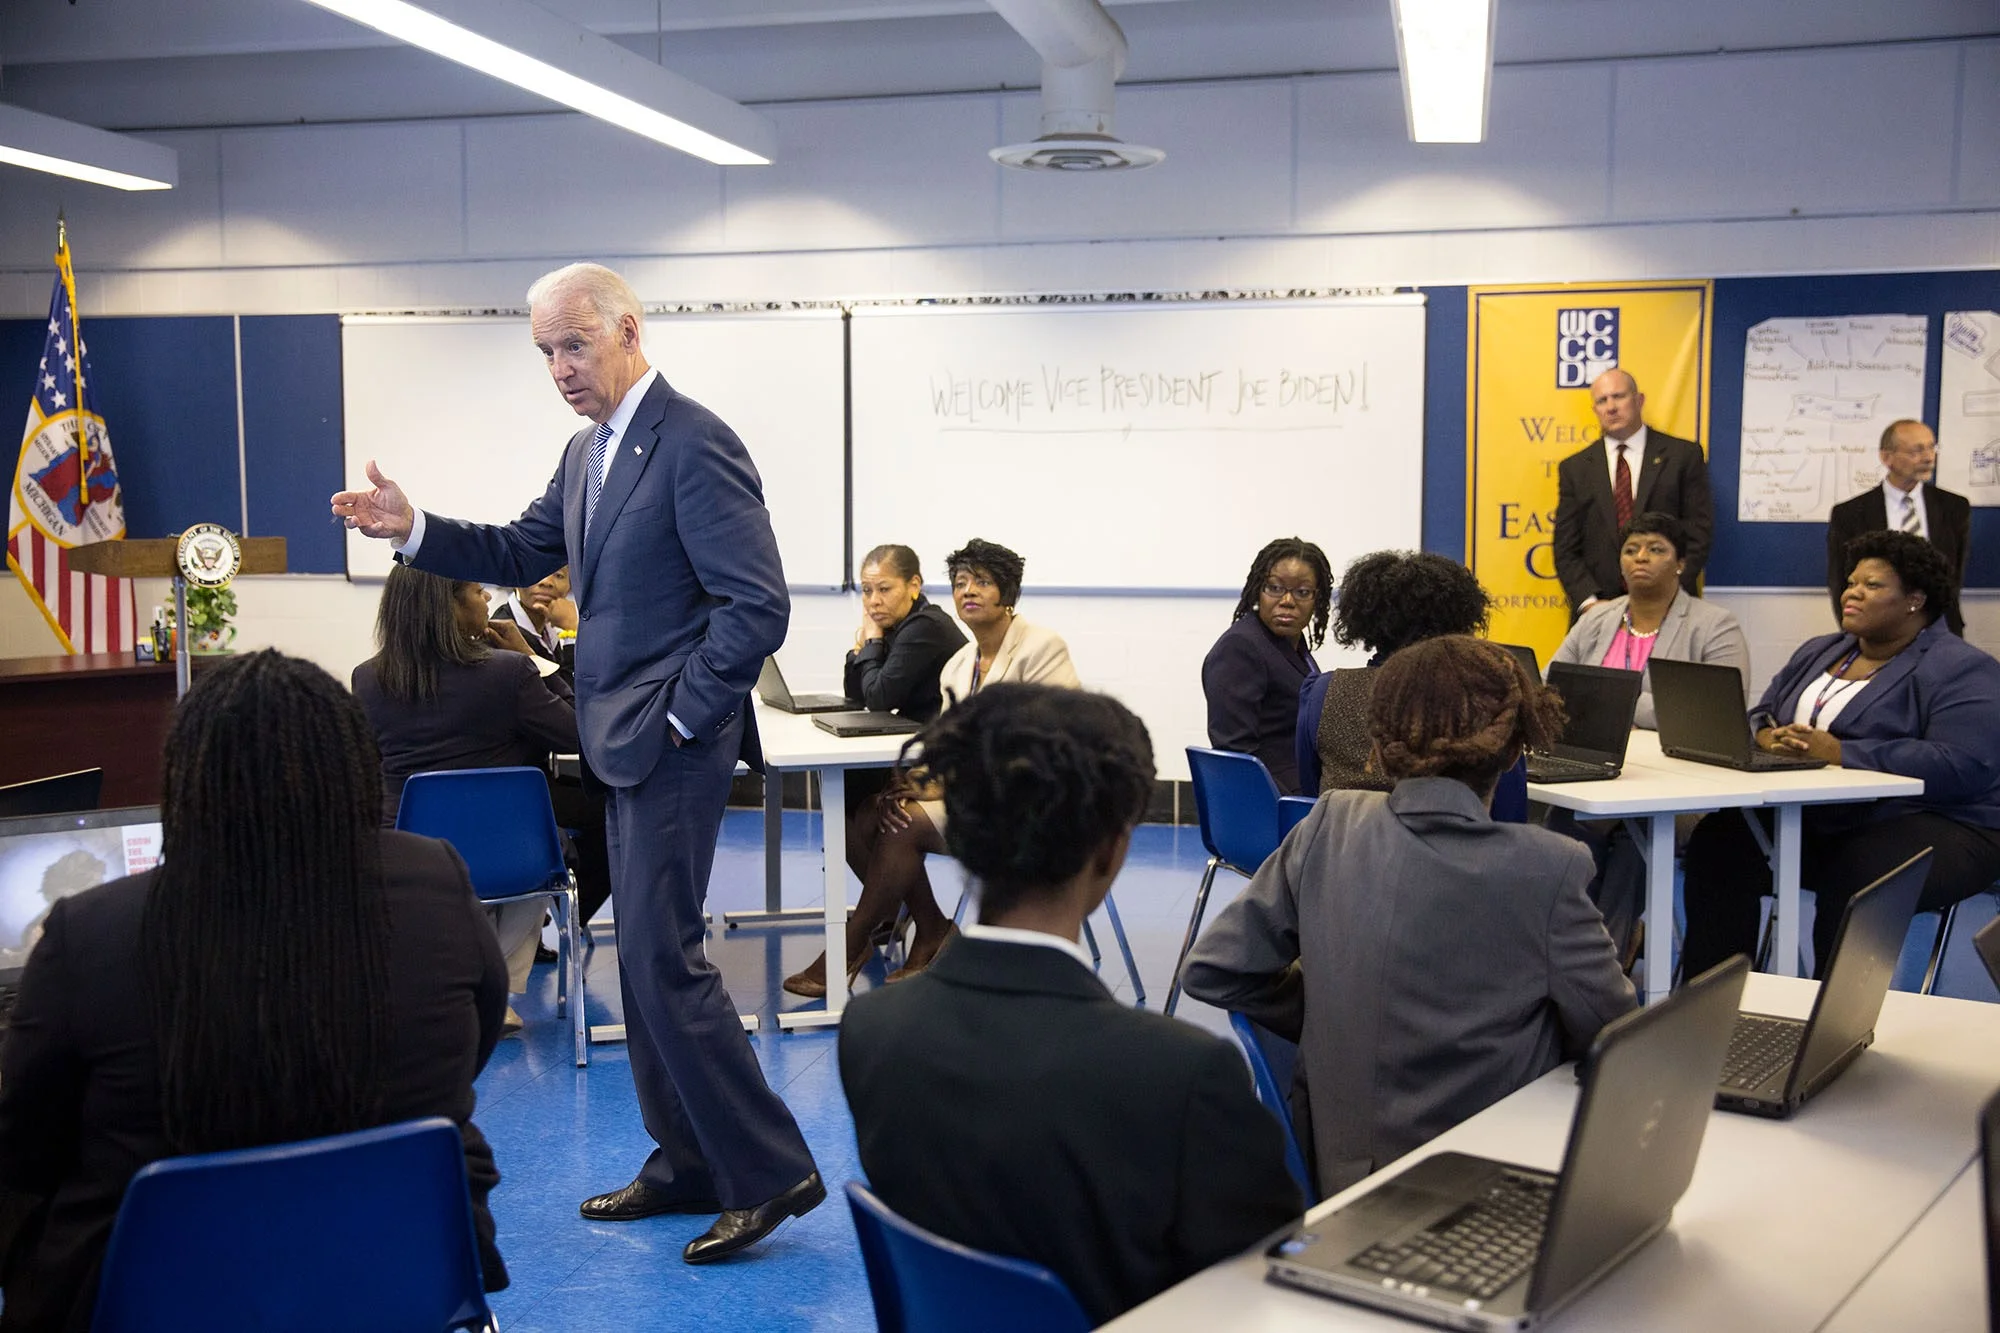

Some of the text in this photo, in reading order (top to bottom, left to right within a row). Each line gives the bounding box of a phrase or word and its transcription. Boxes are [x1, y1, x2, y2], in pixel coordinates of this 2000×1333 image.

[930, 361, 1369, 423] WELCOME VICE PRESIDENT JOE BIDEN!
[1519, 416, 1599, 443] WELC
[24, 482, 66, 536] MICHIGAN
[1491, 594, 1570, 609] ORPORA
